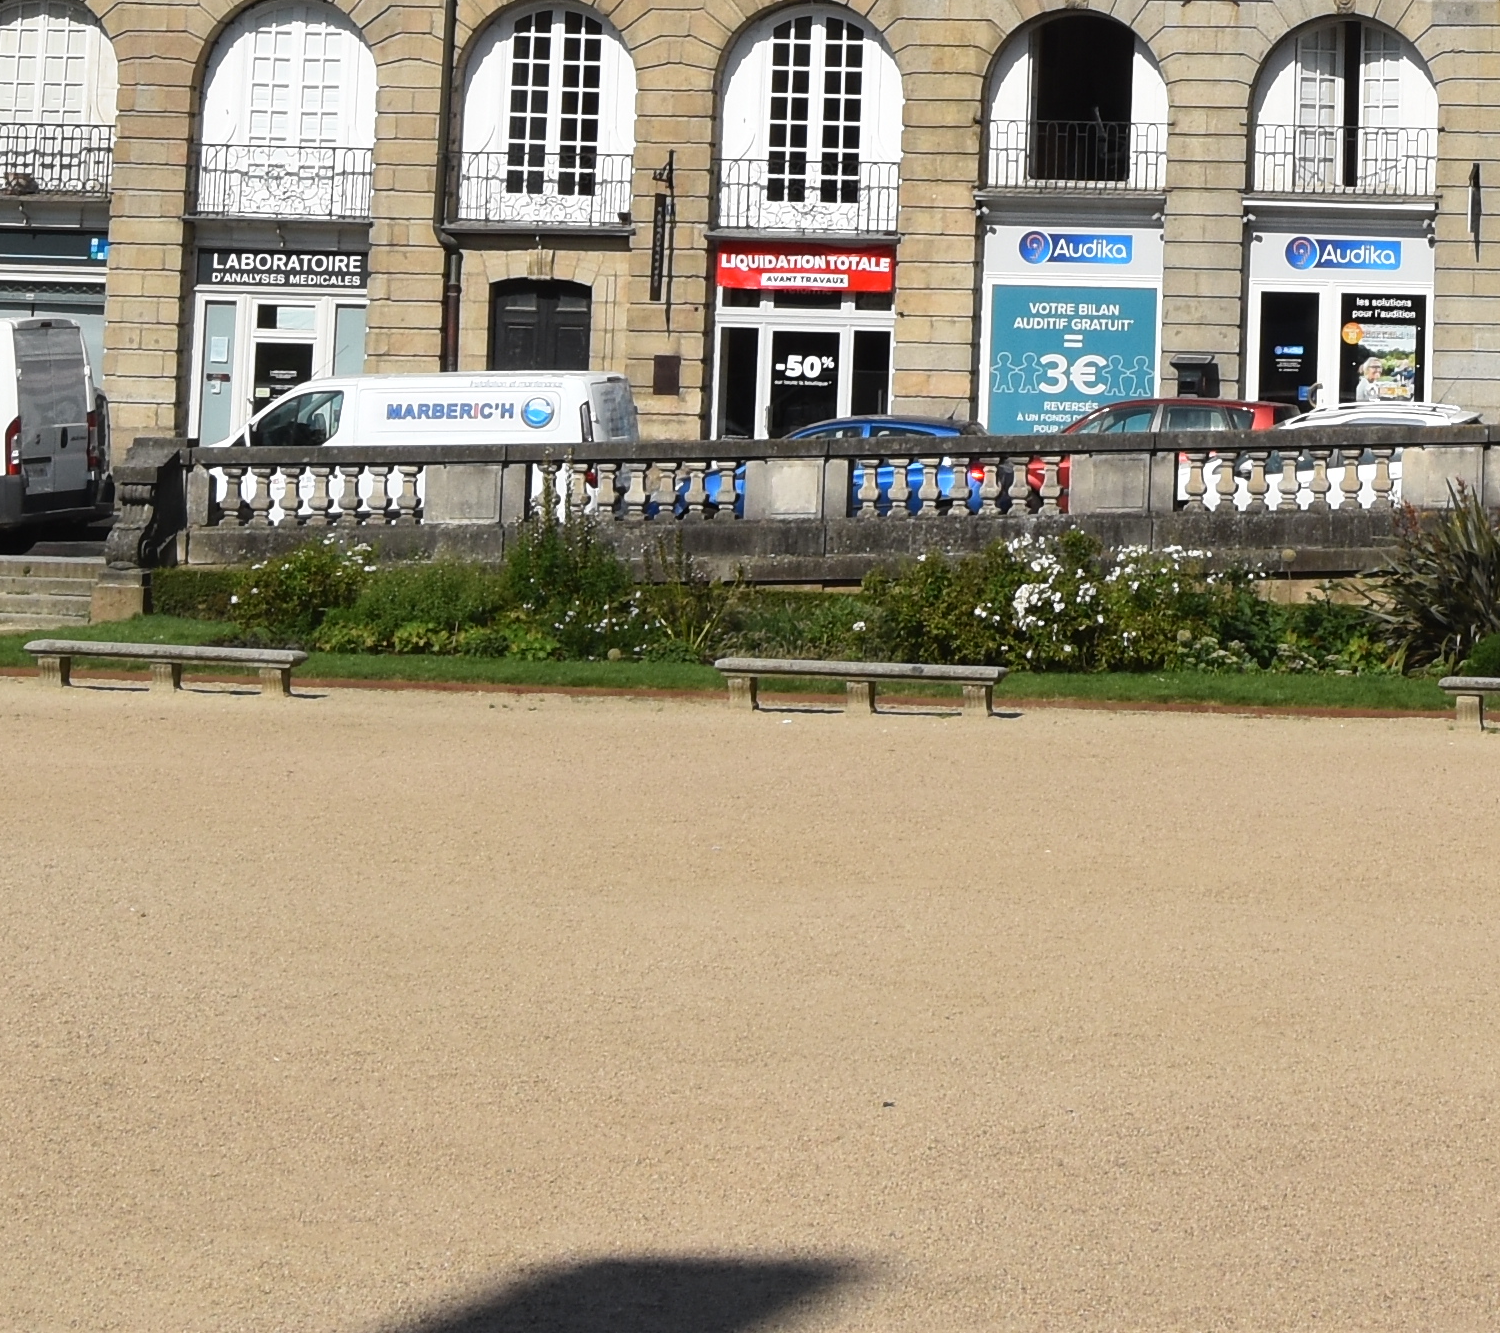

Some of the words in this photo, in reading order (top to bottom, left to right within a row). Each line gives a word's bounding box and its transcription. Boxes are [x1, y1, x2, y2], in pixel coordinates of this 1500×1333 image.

[1053, 238, 1127, 259] Audika
[1321, 244, 1396, 265] Audika
[212, 253, 362, 272] LABORATOIRE
[721, 254, 826, 272] LIQUIDATION
[828, 257, 891, 272] TOTALE
[212, 272, 285, 284] D'ANALYSES
[289, 275, 360, 286] MEDICALES
[766, 275, 798, 283] AVANT
[800, 276, 845, 285] TRAVAUX
[1029, 302, 1076, 315] VOTRE
[1079, 303, 1119, 316] BILAN
[1357, 297, 1369, 306] les
[1372, 298, 1412, 307] solutions
[1352, 310, 1373, 319] pour
[1375, 309, 1416, 318] l'audition
[1013, 317, 1068, 330] AUDITIF
[775, 354, 835, 378] -50%
[1039, 353, 1107, 395] 3€
[386, 402, 514, 420] MARBERIC'H
[1044, 400, 1099, 412] REVERSÉS
[1017, 411, 1024, 421] À
[1025, 413, 1038, 421] UN
[1040, 414, 1071, 422] FONDS
[1033, 424, 1059, 433] POUR
